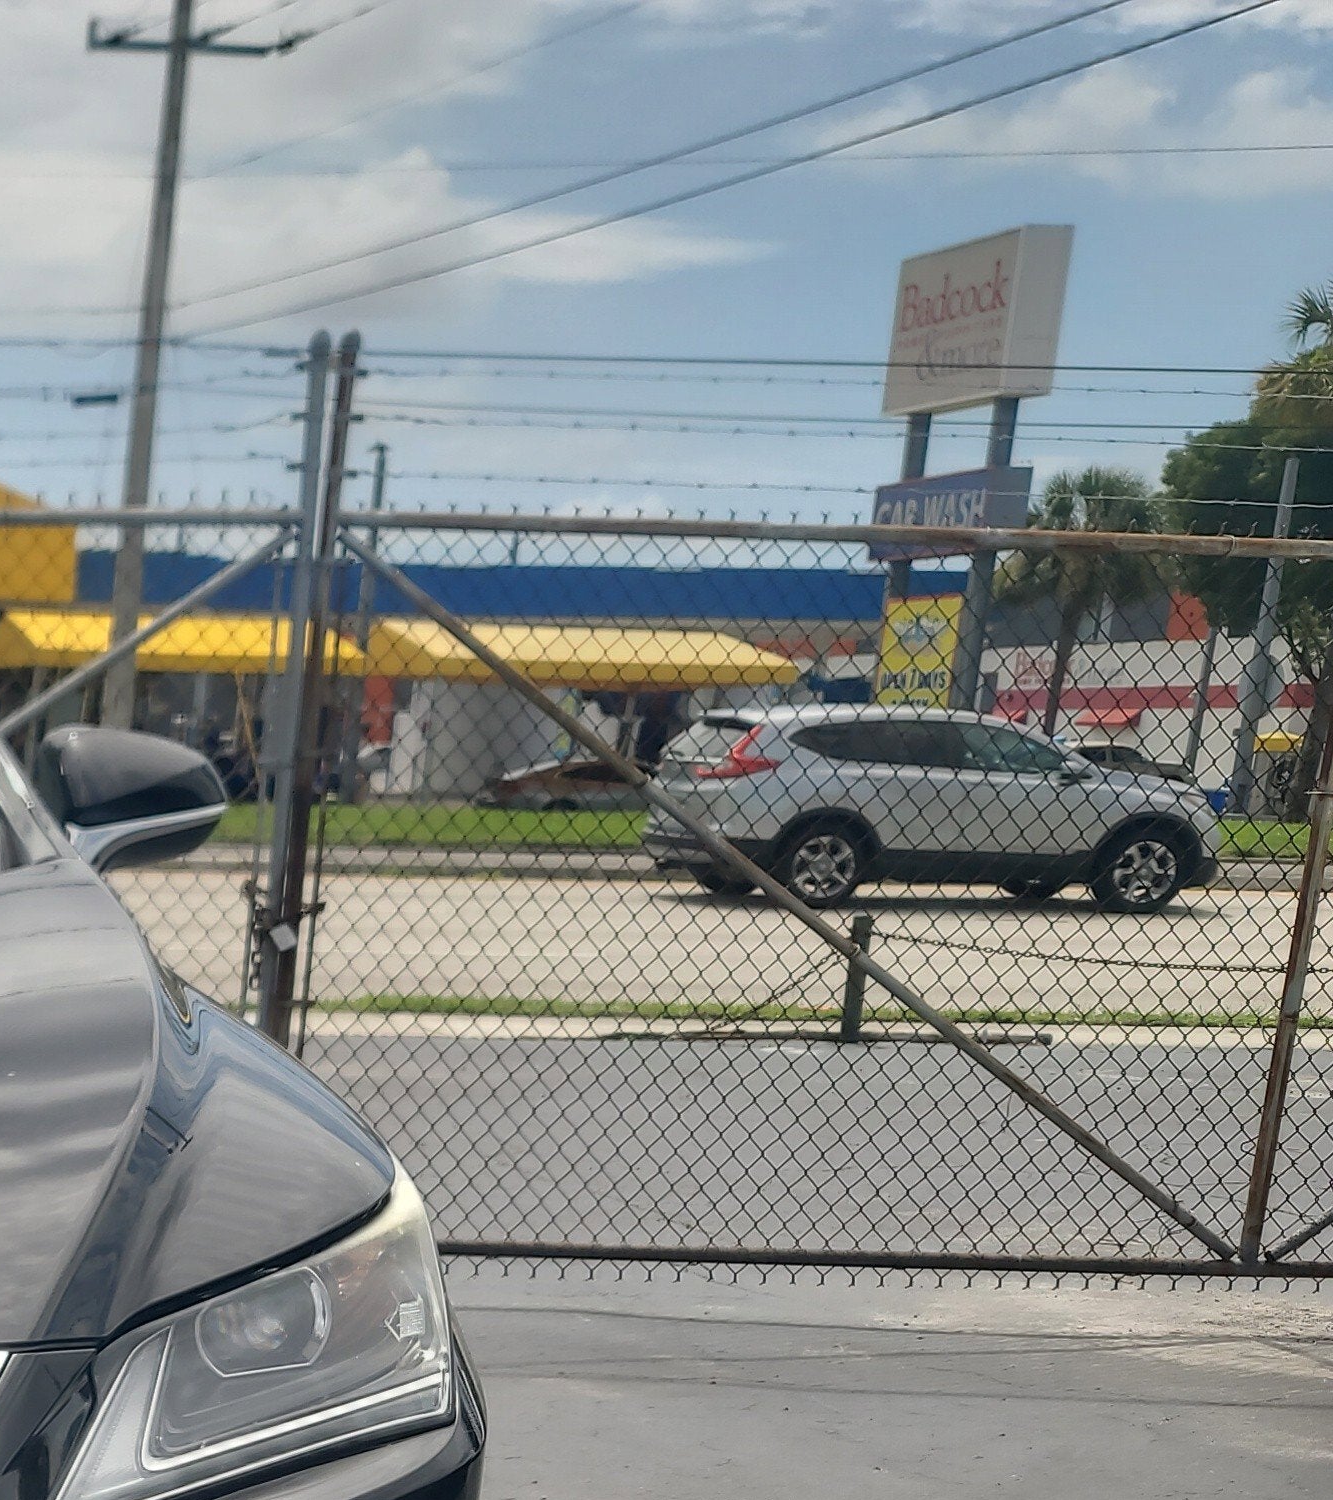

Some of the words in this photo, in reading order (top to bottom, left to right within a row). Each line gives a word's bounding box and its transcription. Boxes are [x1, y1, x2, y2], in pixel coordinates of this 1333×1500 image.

[899, 259, 1009, 333] Badcock
[875, 498, 918, 526] CAR
[924, 488, 986, 528] WASH
